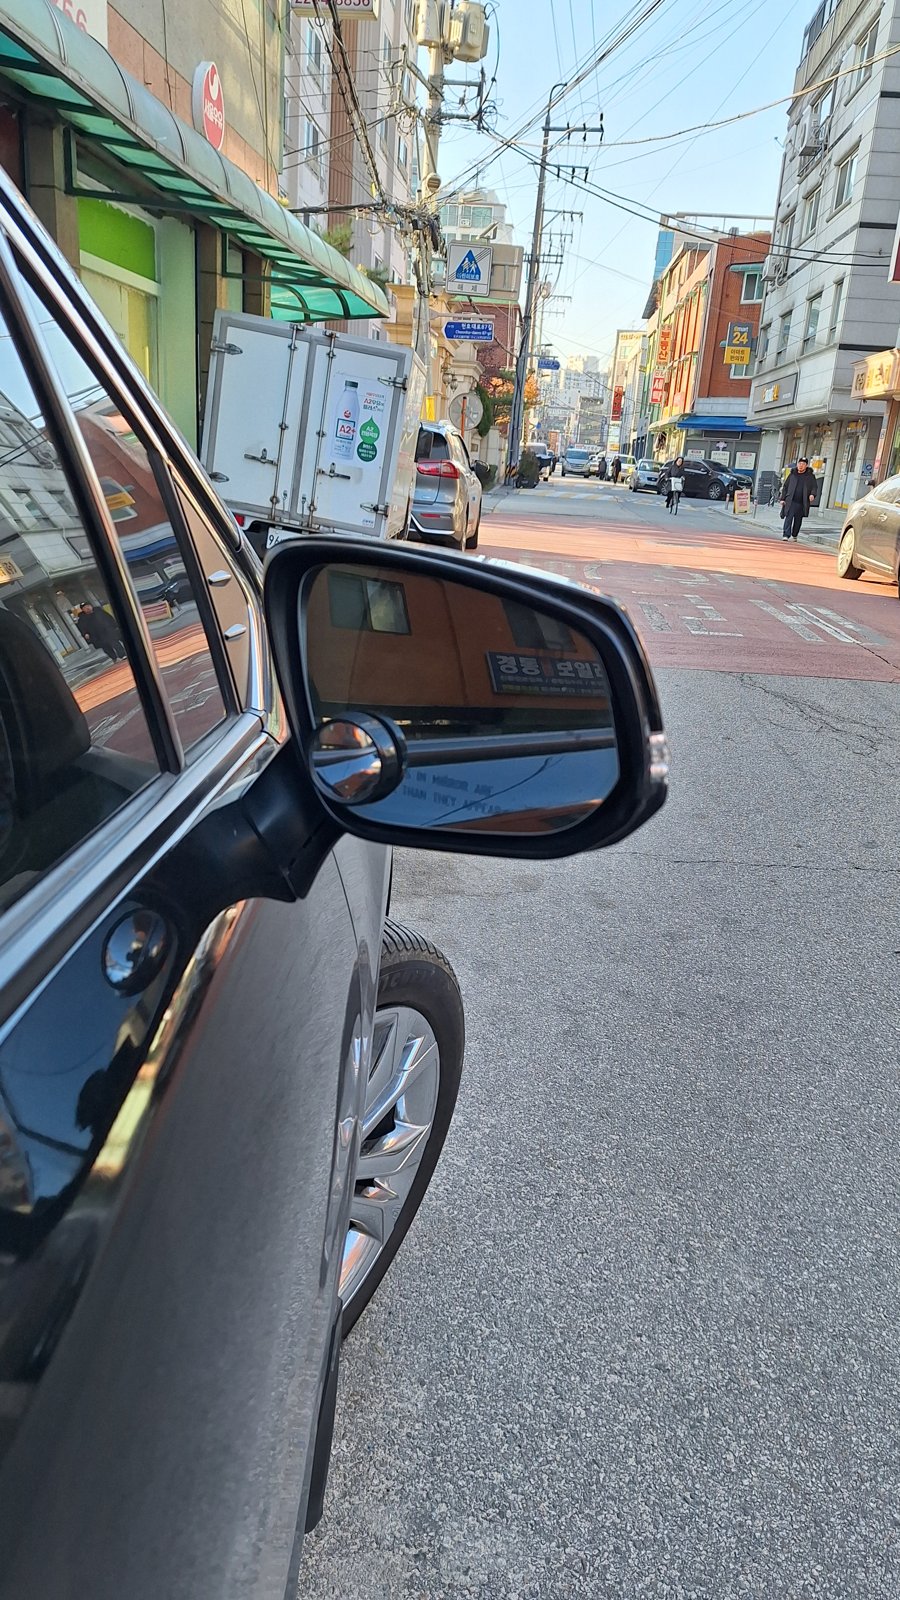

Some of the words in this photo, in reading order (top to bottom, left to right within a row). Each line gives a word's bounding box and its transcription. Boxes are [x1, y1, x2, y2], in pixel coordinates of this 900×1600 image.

[658, 331, 671, 361] 부동산
[732, 332, 749, 345] 24
[496, 655, 541, 675] 경동
